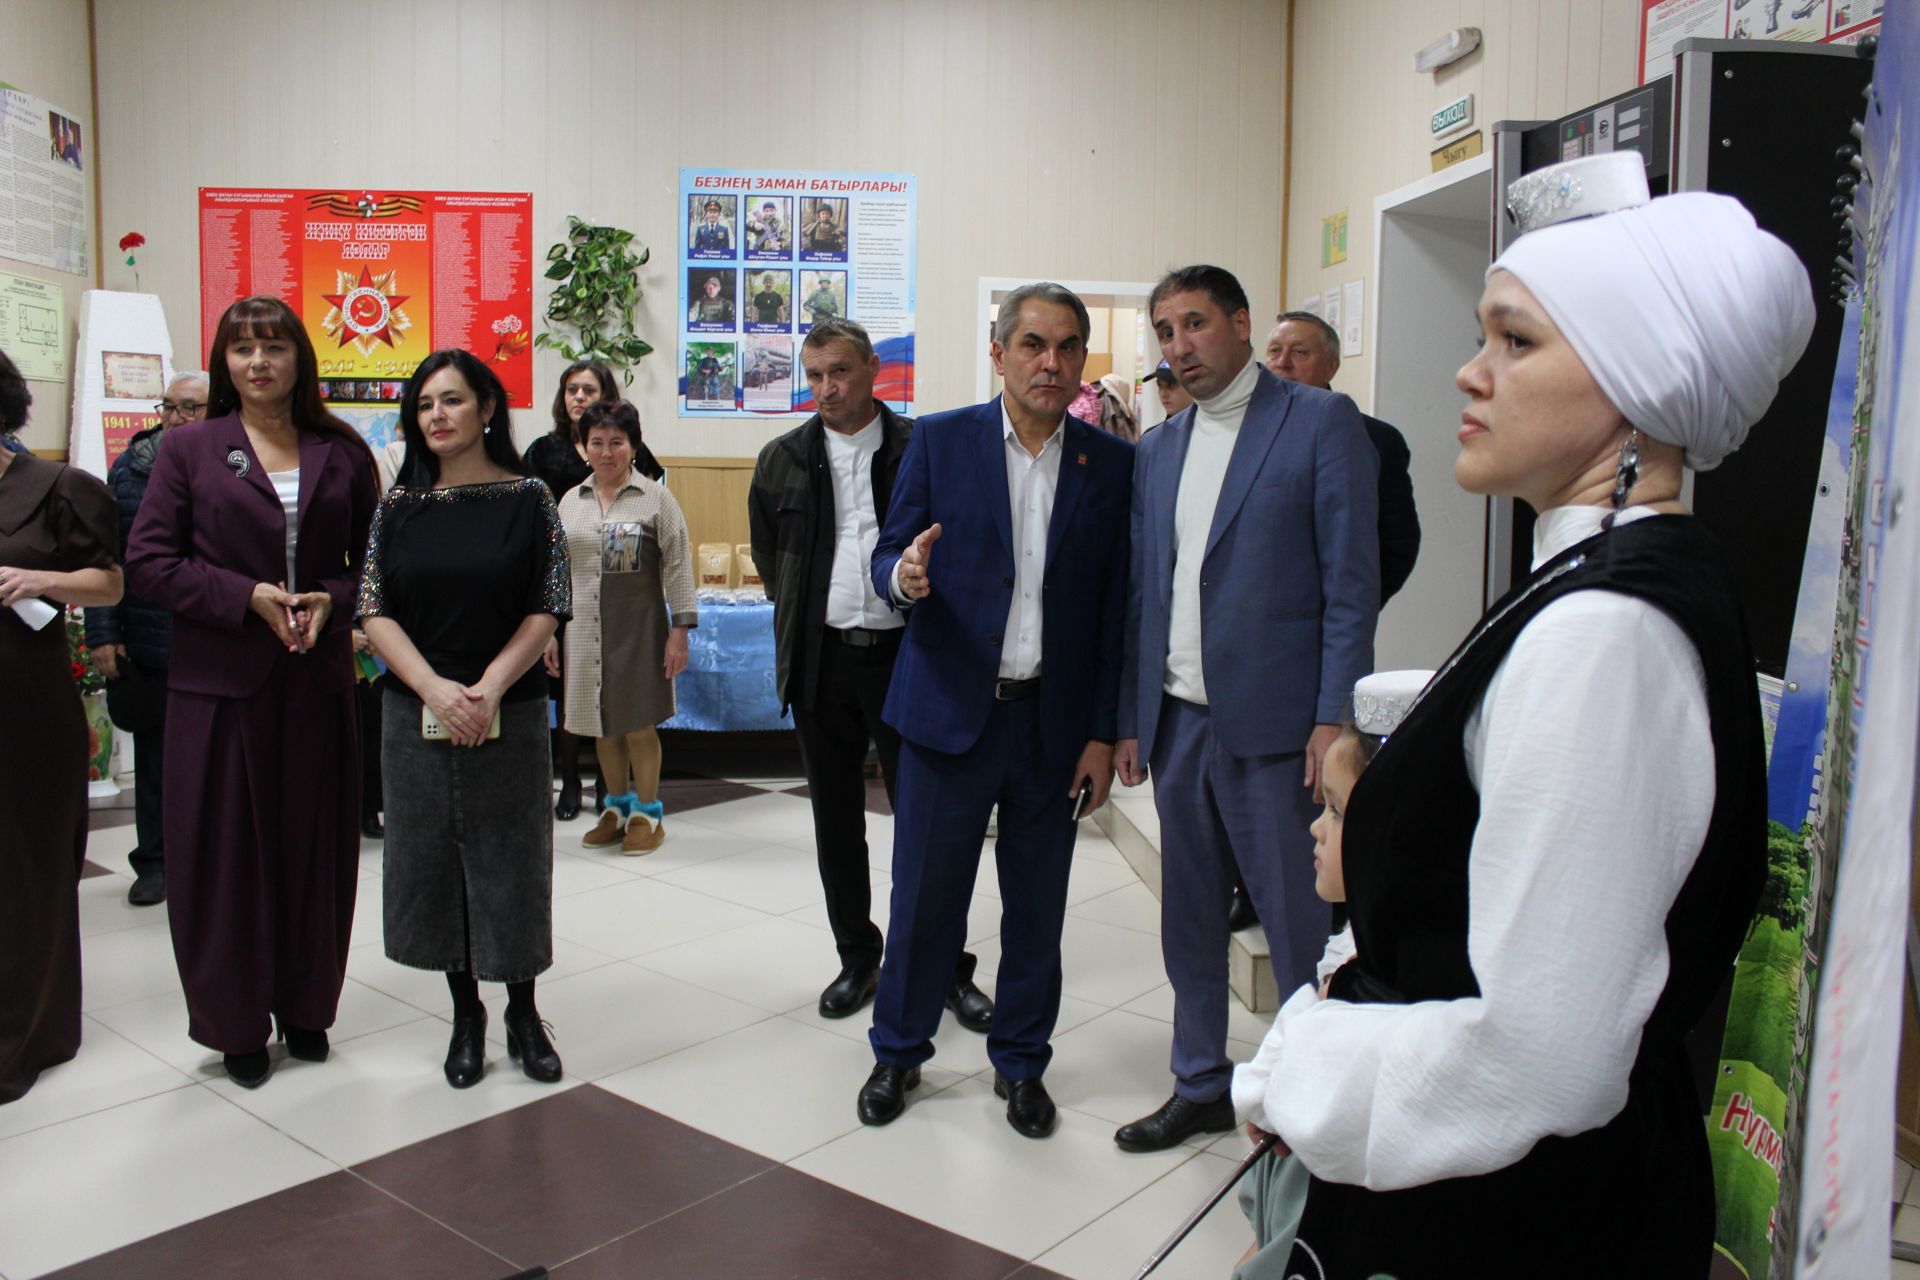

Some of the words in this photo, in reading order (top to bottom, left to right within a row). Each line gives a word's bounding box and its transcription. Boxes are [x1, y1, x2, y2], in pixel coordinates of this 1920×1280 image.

[1432, 102, 1466, 131] ВЫХОД
[1442, 145, 1468, 164] Чыгу
[694, 176, 752, 190] БЕЗНЕҢ
[755, 178, 806, 190] ЗАМАН
[810, 179, 908, 193] БАТЫРЛАРЫ!
[305, 222, 352, 242] ҖИҢҮ
[355, 223, 427, 241] КИТЕРГӘН
[319, 359, 355, 375] 941
[103, 416, 131, 429] 1941
[142, 417, 162, 430] 194
